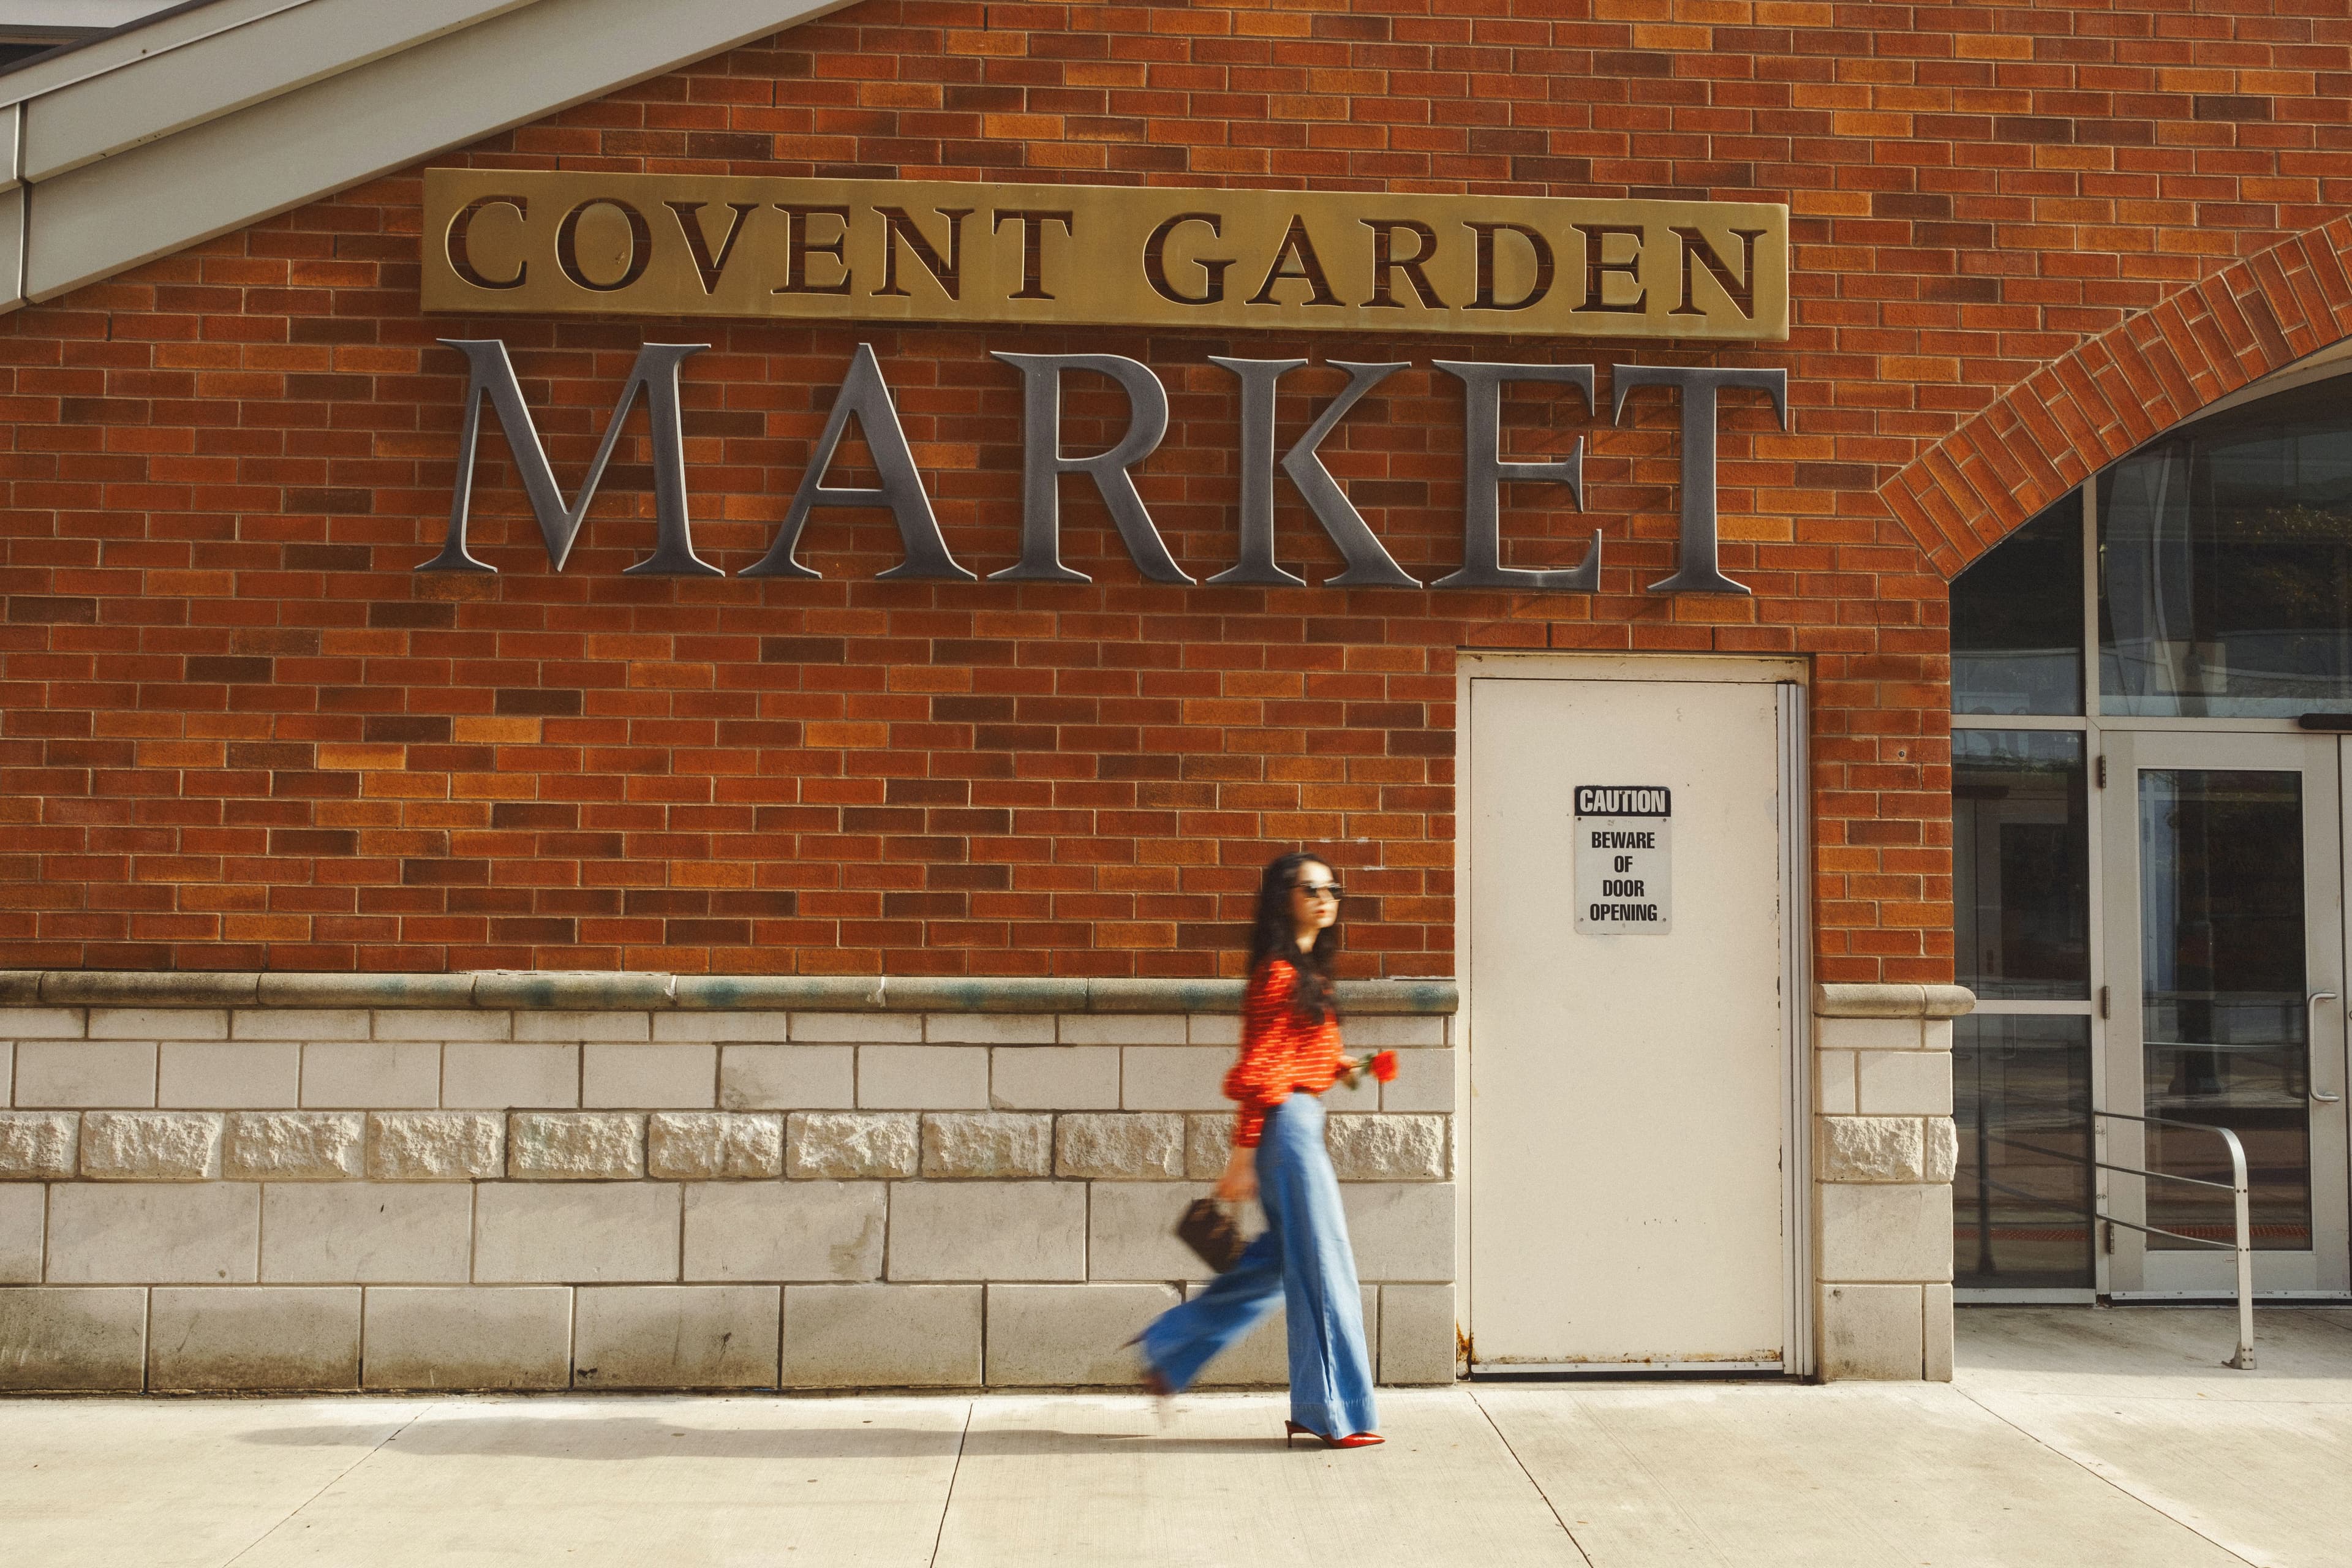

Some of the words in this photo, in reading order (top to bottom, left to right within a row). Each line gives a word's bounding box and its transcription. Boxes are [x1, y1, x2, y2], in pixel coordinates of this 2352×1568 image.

[445, 195, 1074, 301] COVENT
[1143, 212, 1767, 320] GARDEN
[414, 338, 1788, 595] MARKET
[1580, 790, 1665, 813] CAUTION
[1591, 832, 1655, 849] BEWARE
[1614, 855, 1633, 873] OF
[1602, 880, 1645, 897] DOOR
[1589, 903, 1657, 921] OPENING
